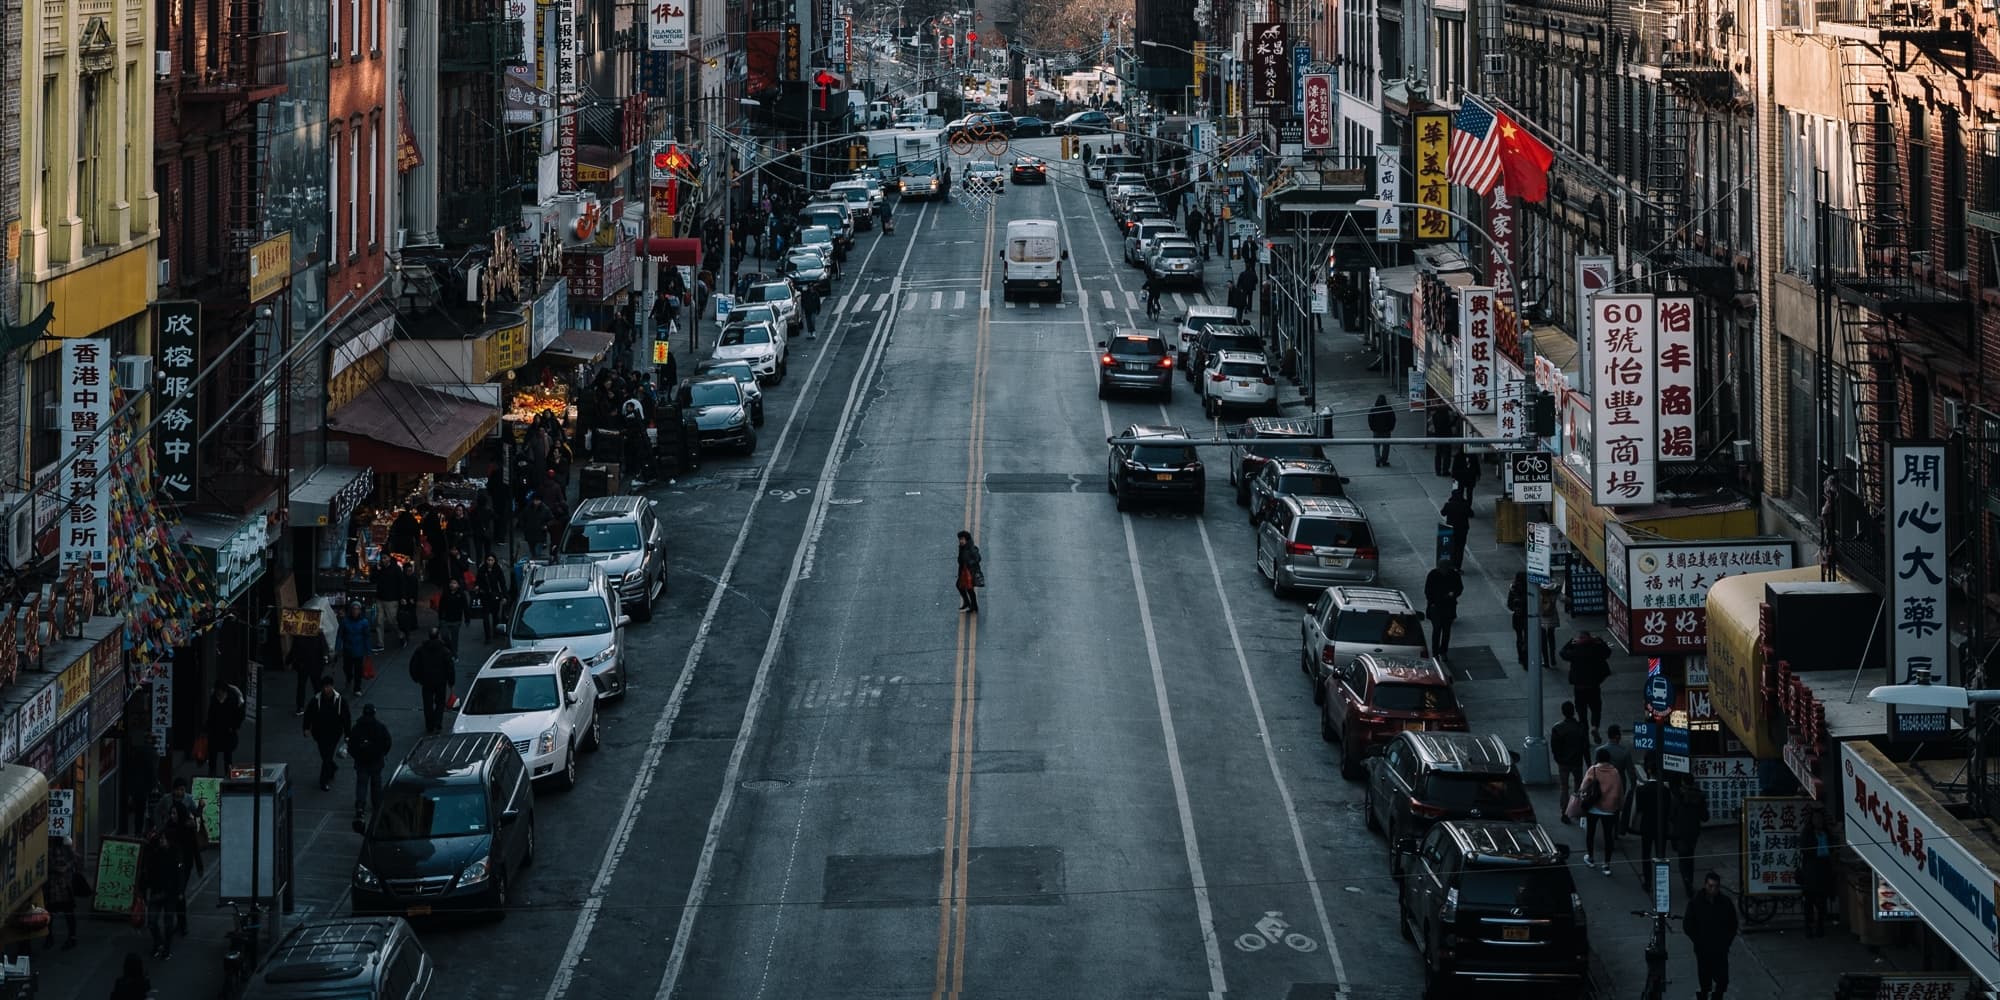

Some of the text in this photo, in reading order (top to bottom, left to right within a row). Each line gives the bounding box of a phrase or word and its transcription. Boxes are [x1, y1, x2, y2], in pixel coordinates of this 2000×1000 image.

[1420, 120, 1447, 234] 華美商場
[1470, 295, 1491, 411] 興旺旺商場
[71, 343, 100, 547] 香港中醫骨傷科診所
[1515, 473, 1550, 482] BIKE LANE
[1676, 636, 1694, 645] TEL
[1634, 723, 1648, 734] M9
[1635, 737, 1653, 749] M22
